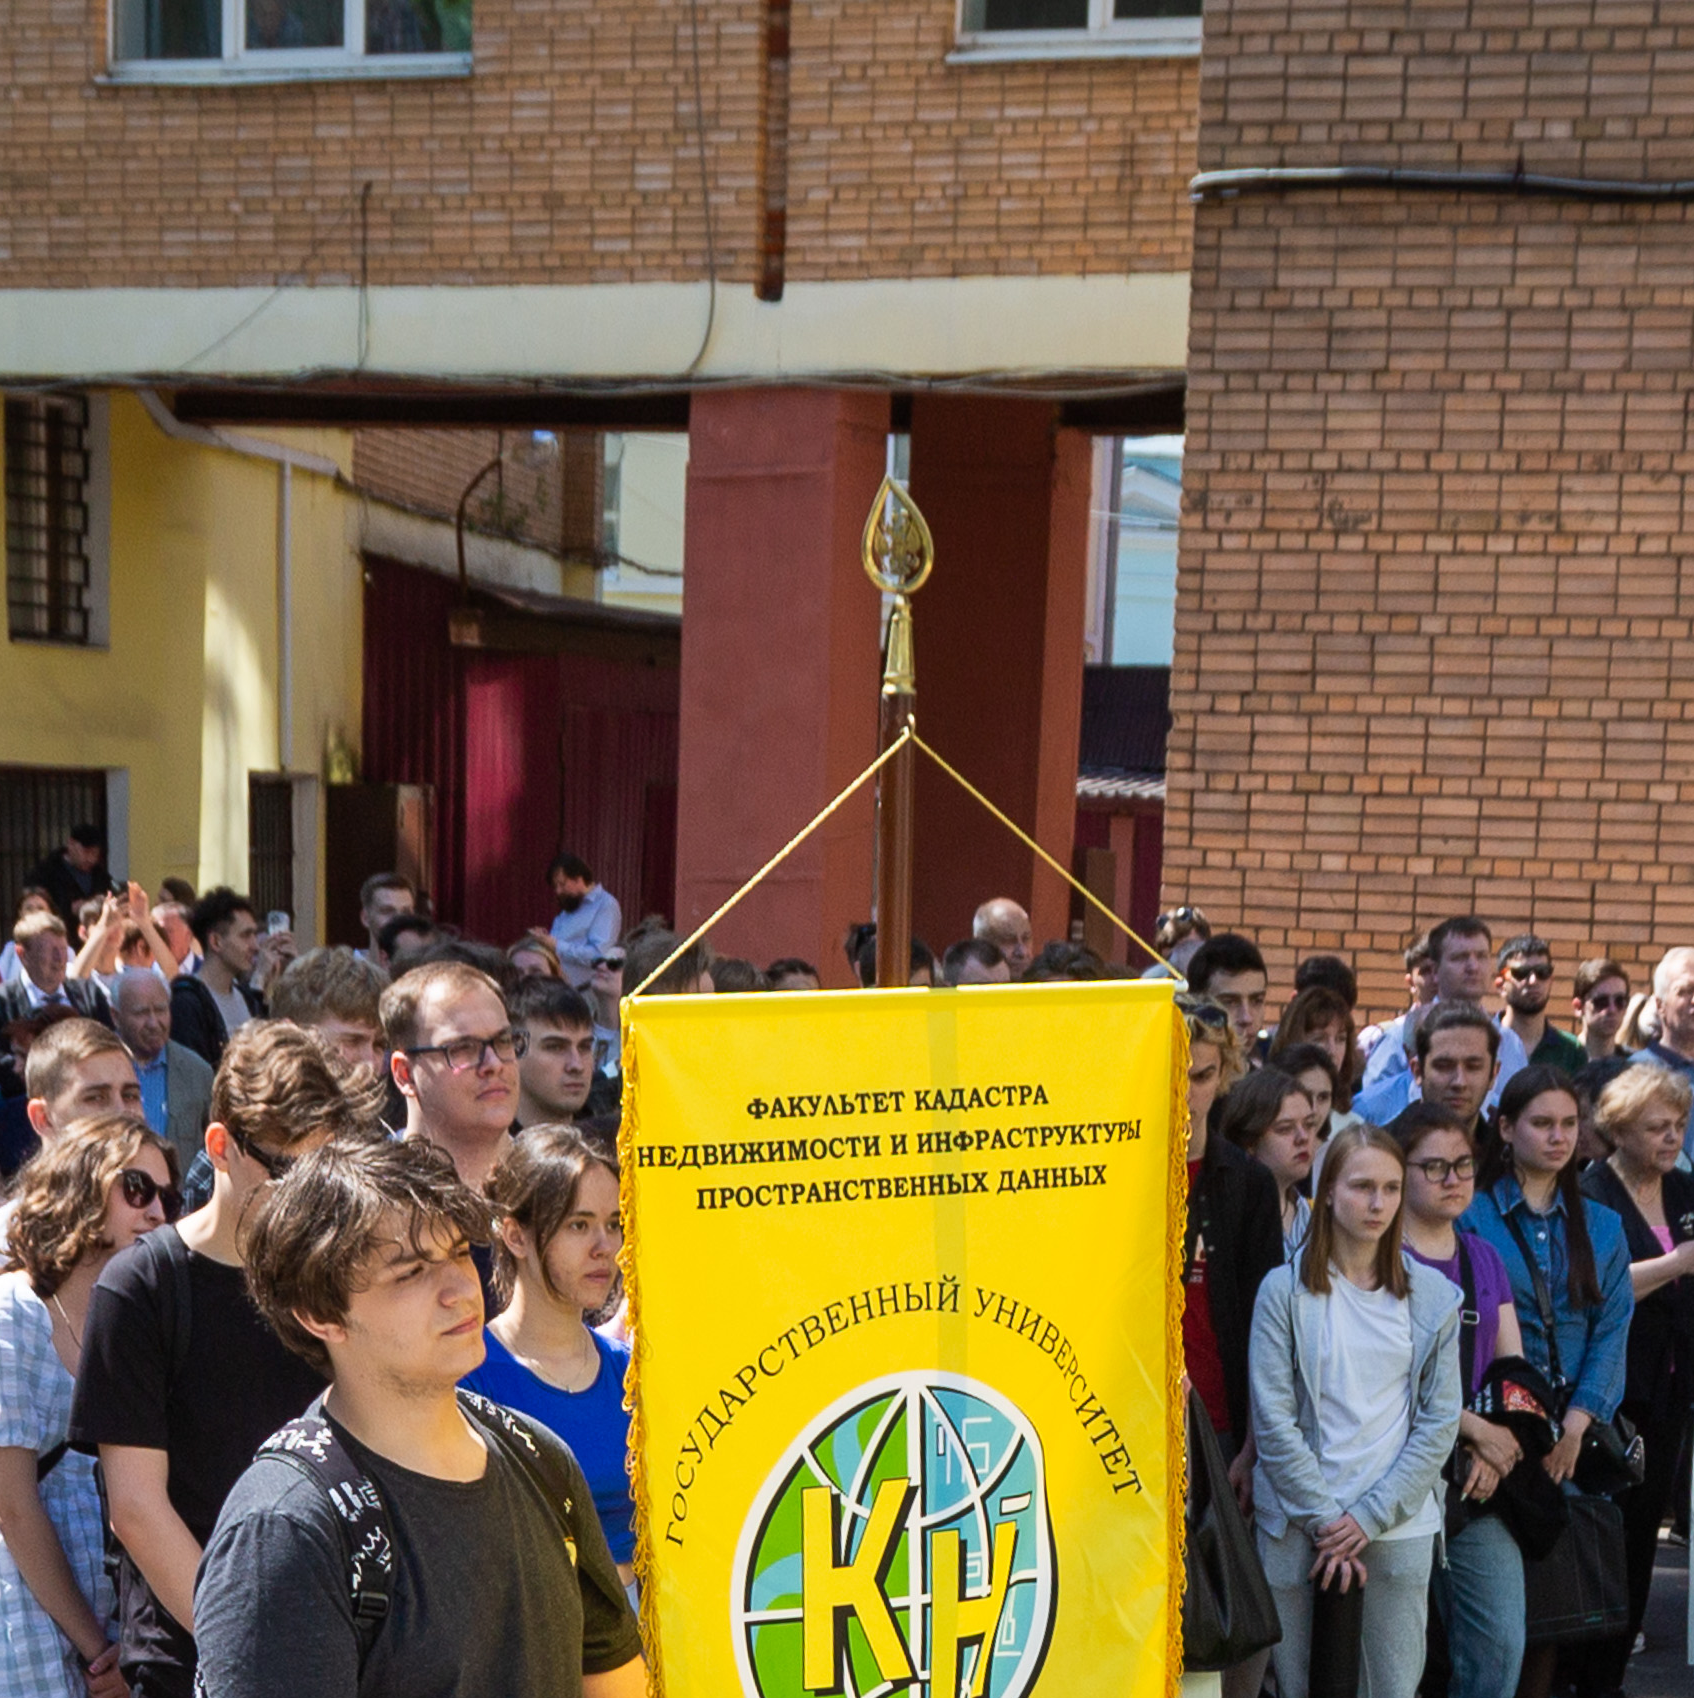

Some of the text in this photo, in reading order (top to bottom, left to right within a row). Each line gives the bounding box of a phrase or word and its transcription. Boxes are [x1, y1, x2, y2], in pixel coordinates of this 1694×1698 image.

[746, 1084, 1049, 1120] ФАКУЛЬТЕТ КАДАСТРА
[637, 1119, 1142, 1171] НЕДВИЖИМОСТИ И ИНФРАСТРУКТУРЫ
[696, 1164, 1108, 1211] ПРОСТРАНСТВЕННЫХ ДАННЫХ
[665, 1274, 1143, 1548] ГОСУДАРСТВЕННЫЙ УНИВЕРСИТЕТ
